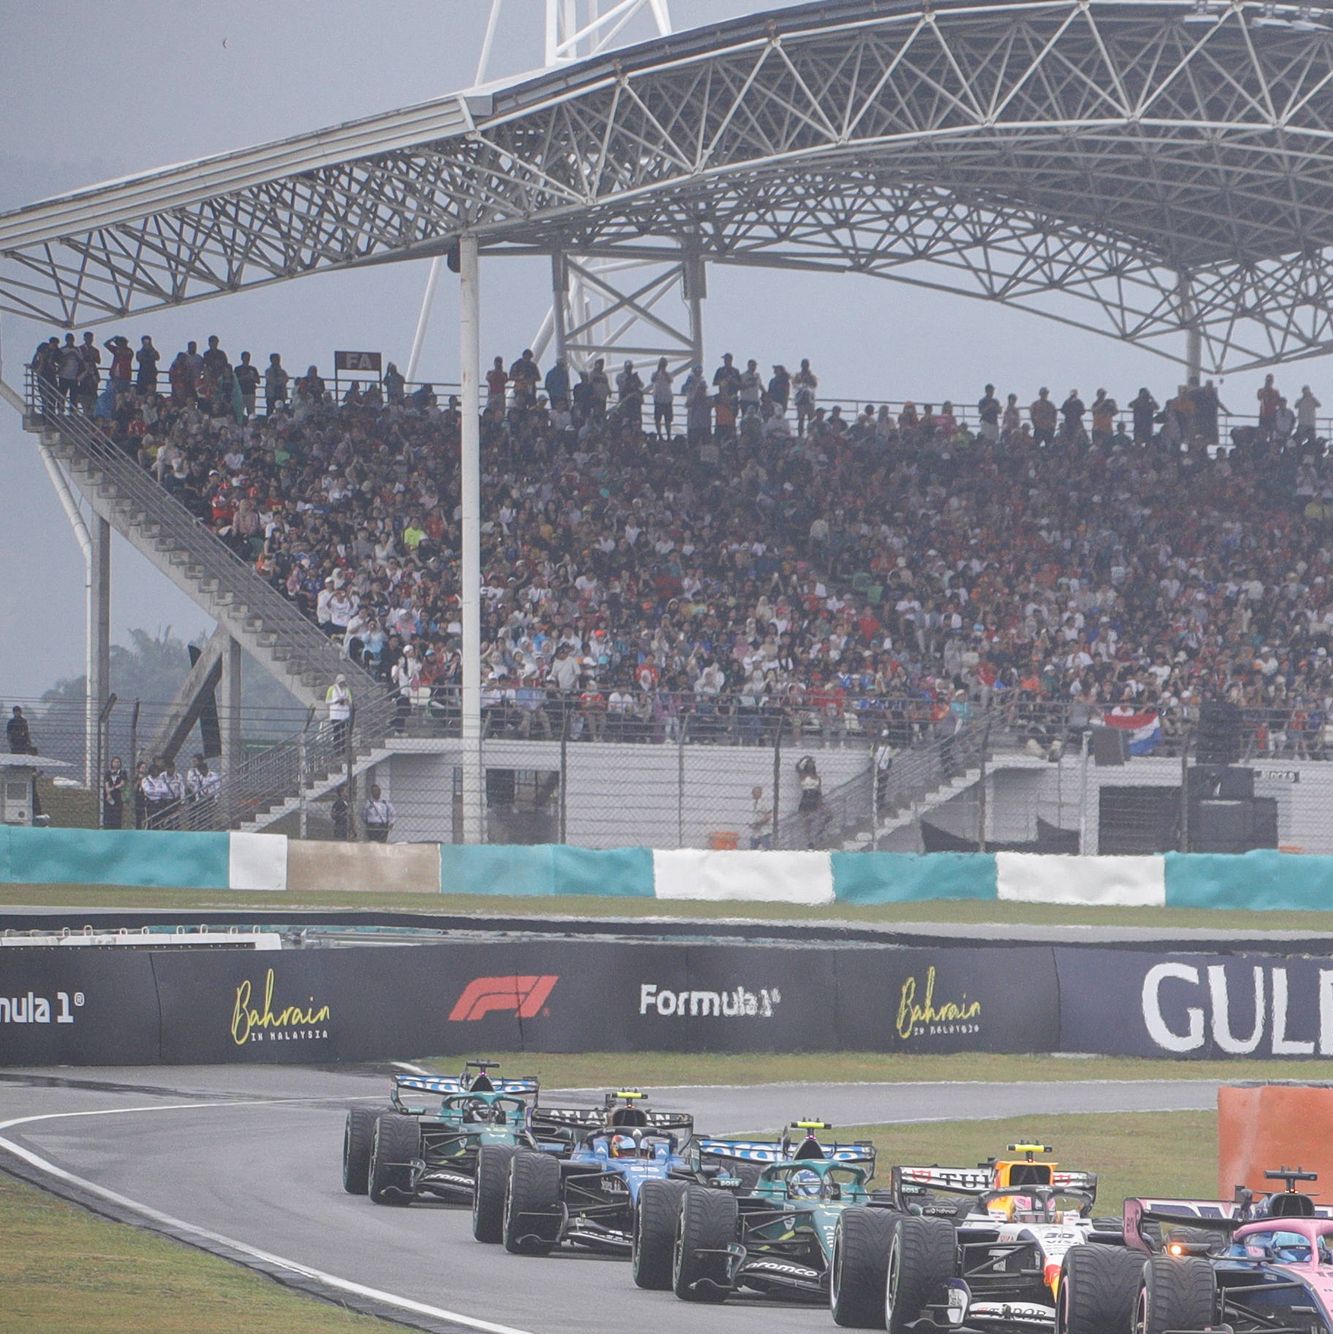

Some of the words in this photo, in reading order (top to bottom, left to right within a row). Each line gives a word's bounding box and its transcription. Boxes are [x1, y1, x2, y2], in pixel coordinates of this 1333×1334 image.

[346, 353, 372, 369] FA
[231, 968, 330, 1045] Bahrain
[639, 983, 757, 1018] Formula
[897, 966, 981, 1038] Bahrain
[251, 1032, 263, 1041] IN
[270, 1030, 328, 1041] MALAYSIA
[745, 1261, 818, 1277] aramco
